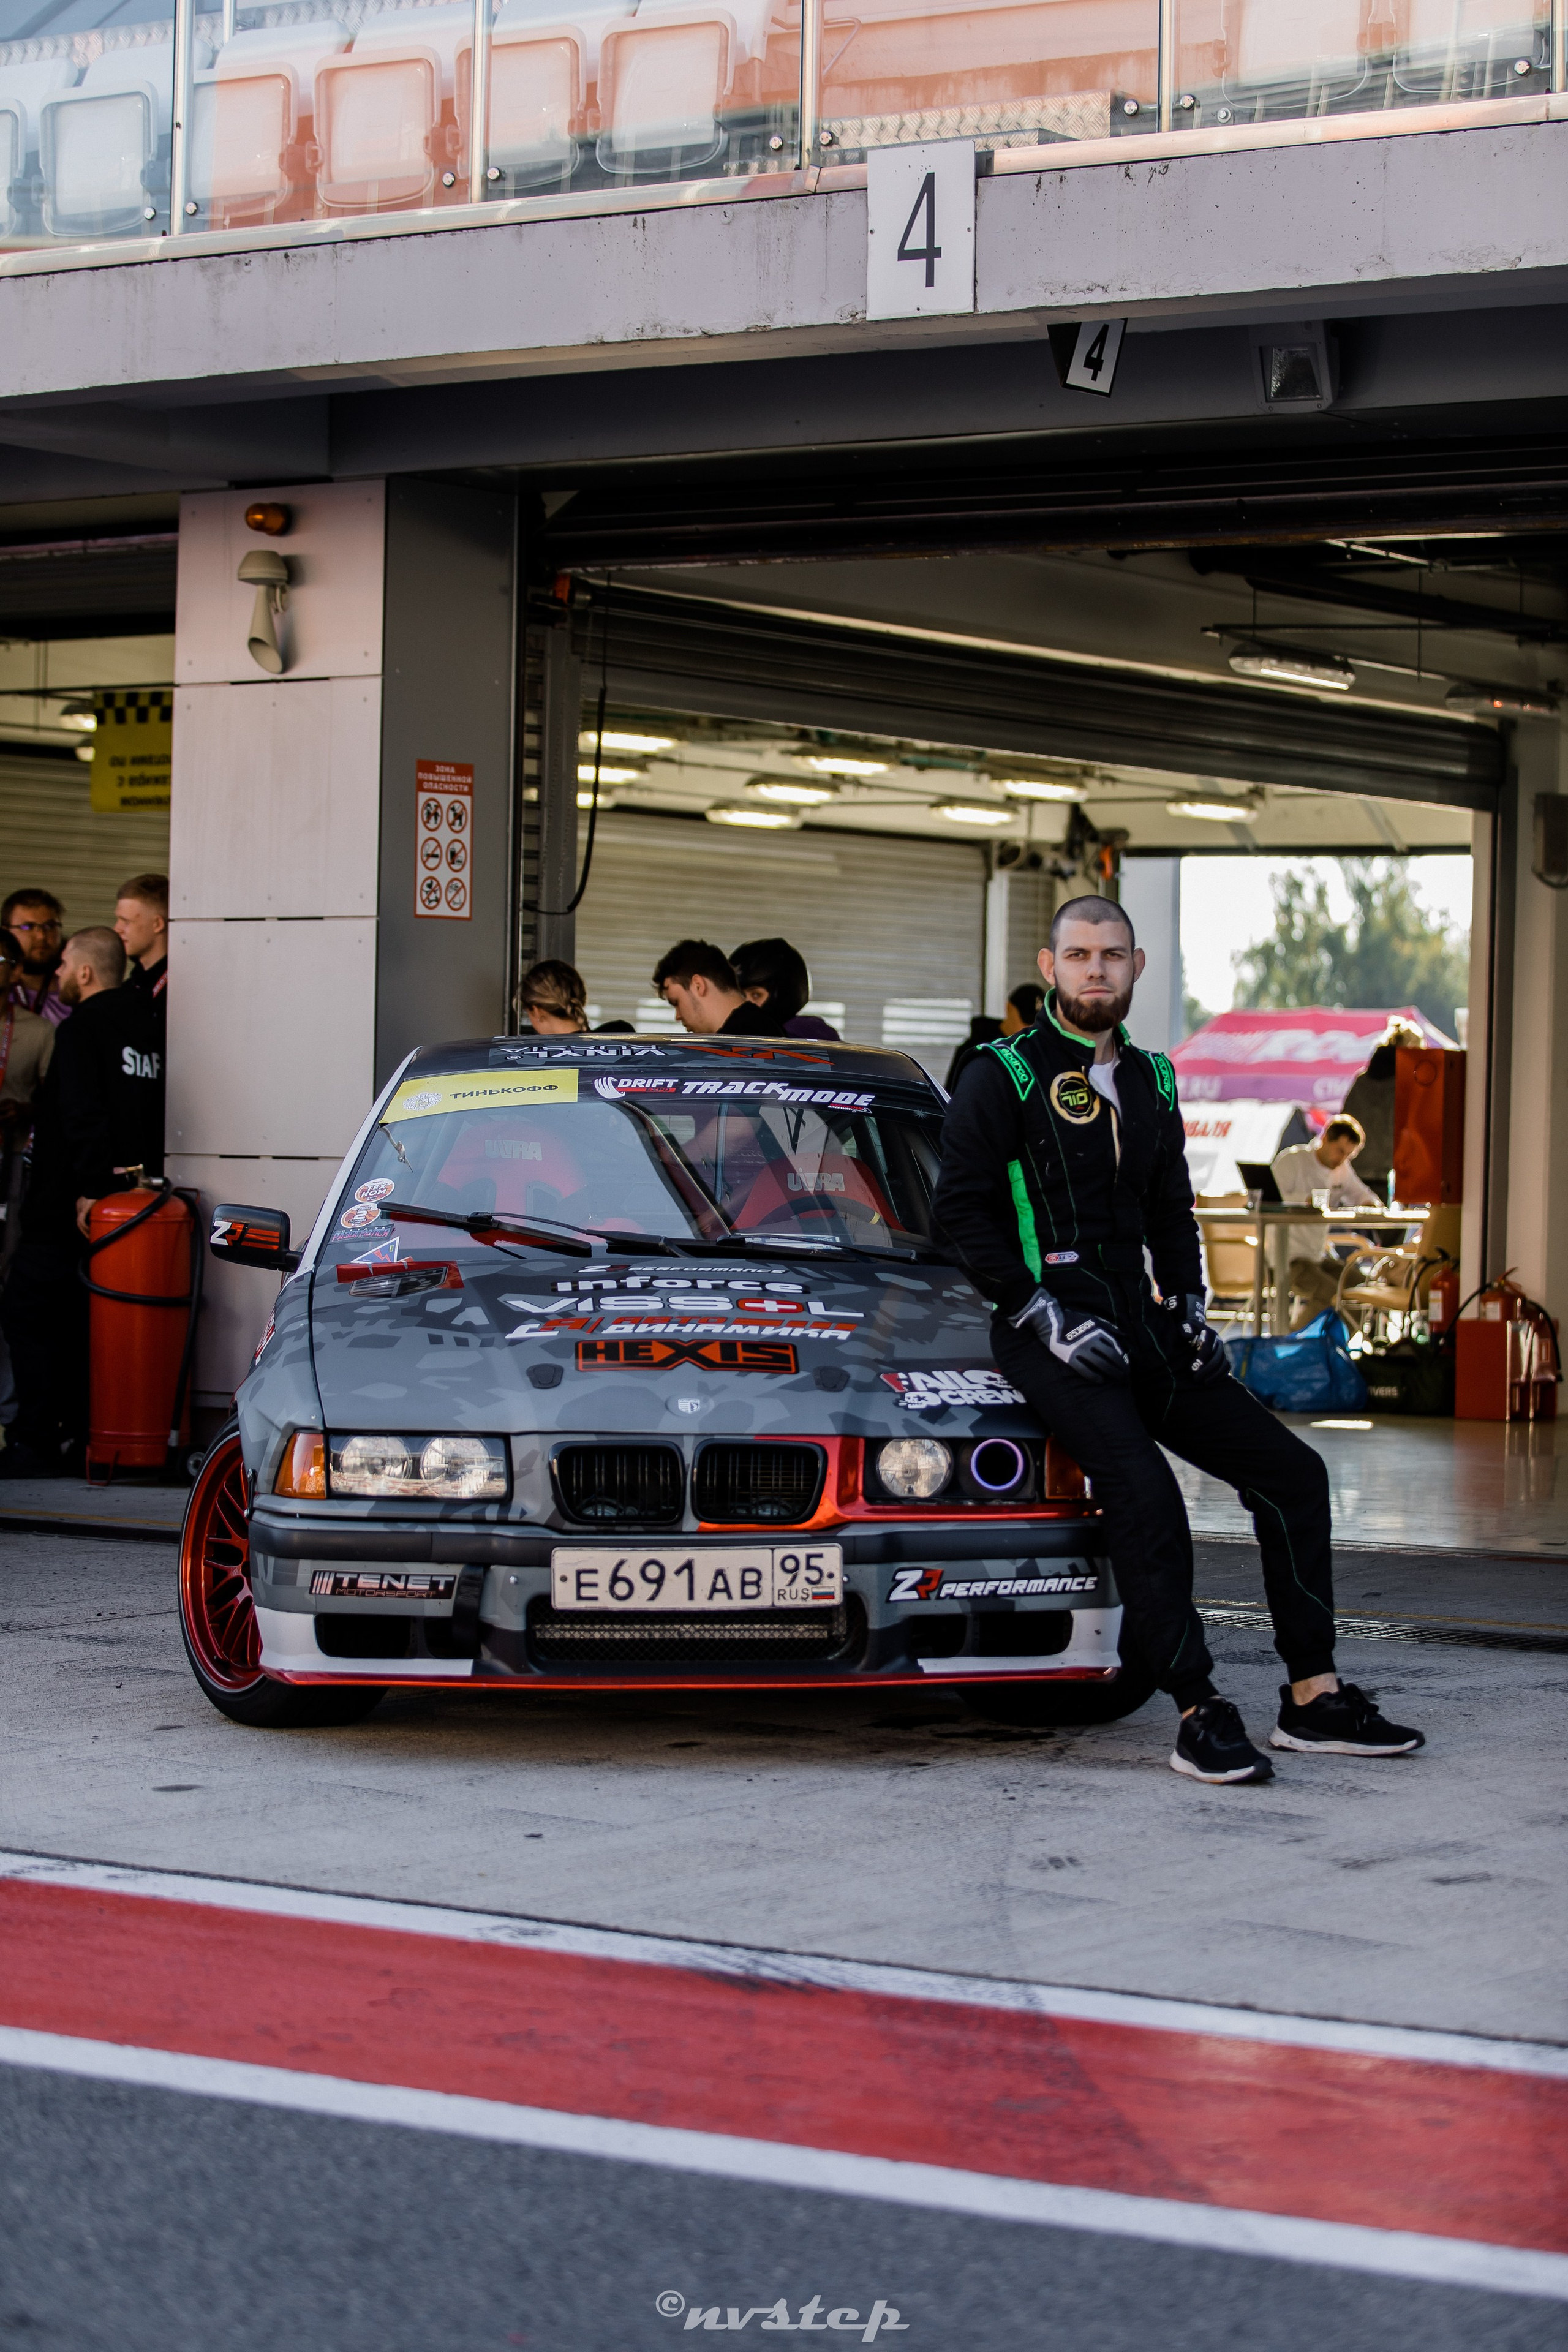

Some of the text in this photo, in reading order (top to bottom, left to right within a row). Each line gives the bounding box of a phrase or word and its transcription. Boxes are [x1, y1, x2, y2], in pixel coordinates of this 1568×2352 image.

[897, 172, 942, 287] 4
[1082, 323, 1110, 382] 4
[450, 1084, 559, 1099] ТИНЬКОФФ
[617, 1079, 679, 1088] DRIFT
[353, 1210, 368, 1219] 2
[557, 1276, 803, 1293] inforce
[601, 1322, 853, 1340] ДИНАМИКА
[581, 1340, 795, 1371] HEXIS
[938, 1389, 1027, 1405] CREW
[780, 1553, 824, 1586] 95
[336, 1573, 454, 1591] TENET
[939, 1576, 1098, 1598] PERFORMANCE
[336, 1588, 436, 1599] MOTORSPORT
[777, 1587, 810, 1602] RUS
